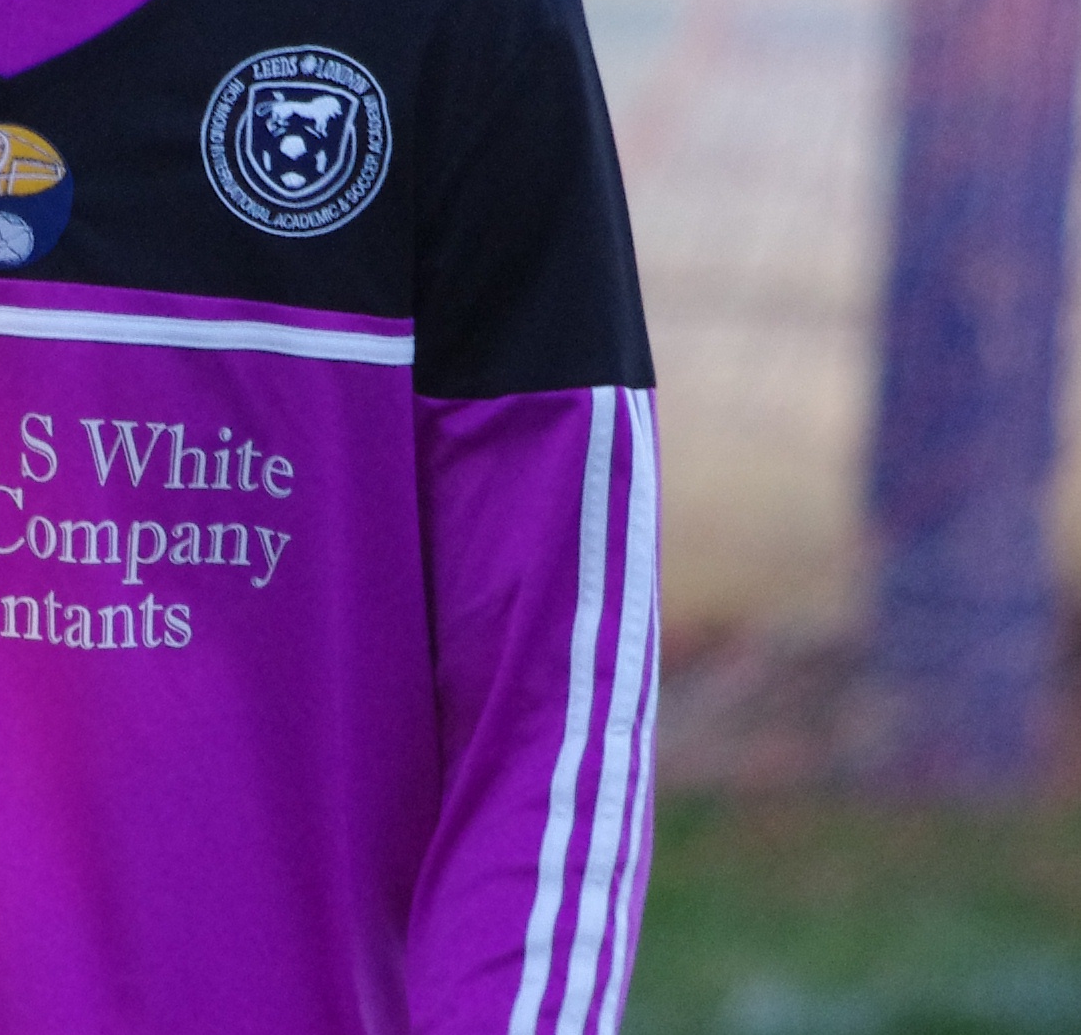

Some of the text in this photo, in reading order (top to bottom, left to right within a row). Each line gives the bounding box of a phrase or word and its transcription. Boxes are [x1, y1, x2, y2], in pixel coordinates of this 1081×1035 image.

[253, 56, 298, 79] LEEDS
[274, 204, 338, 229] ACADEMIC
[21, 413, 57, 483] S
[81, 418, 294, 499] White
